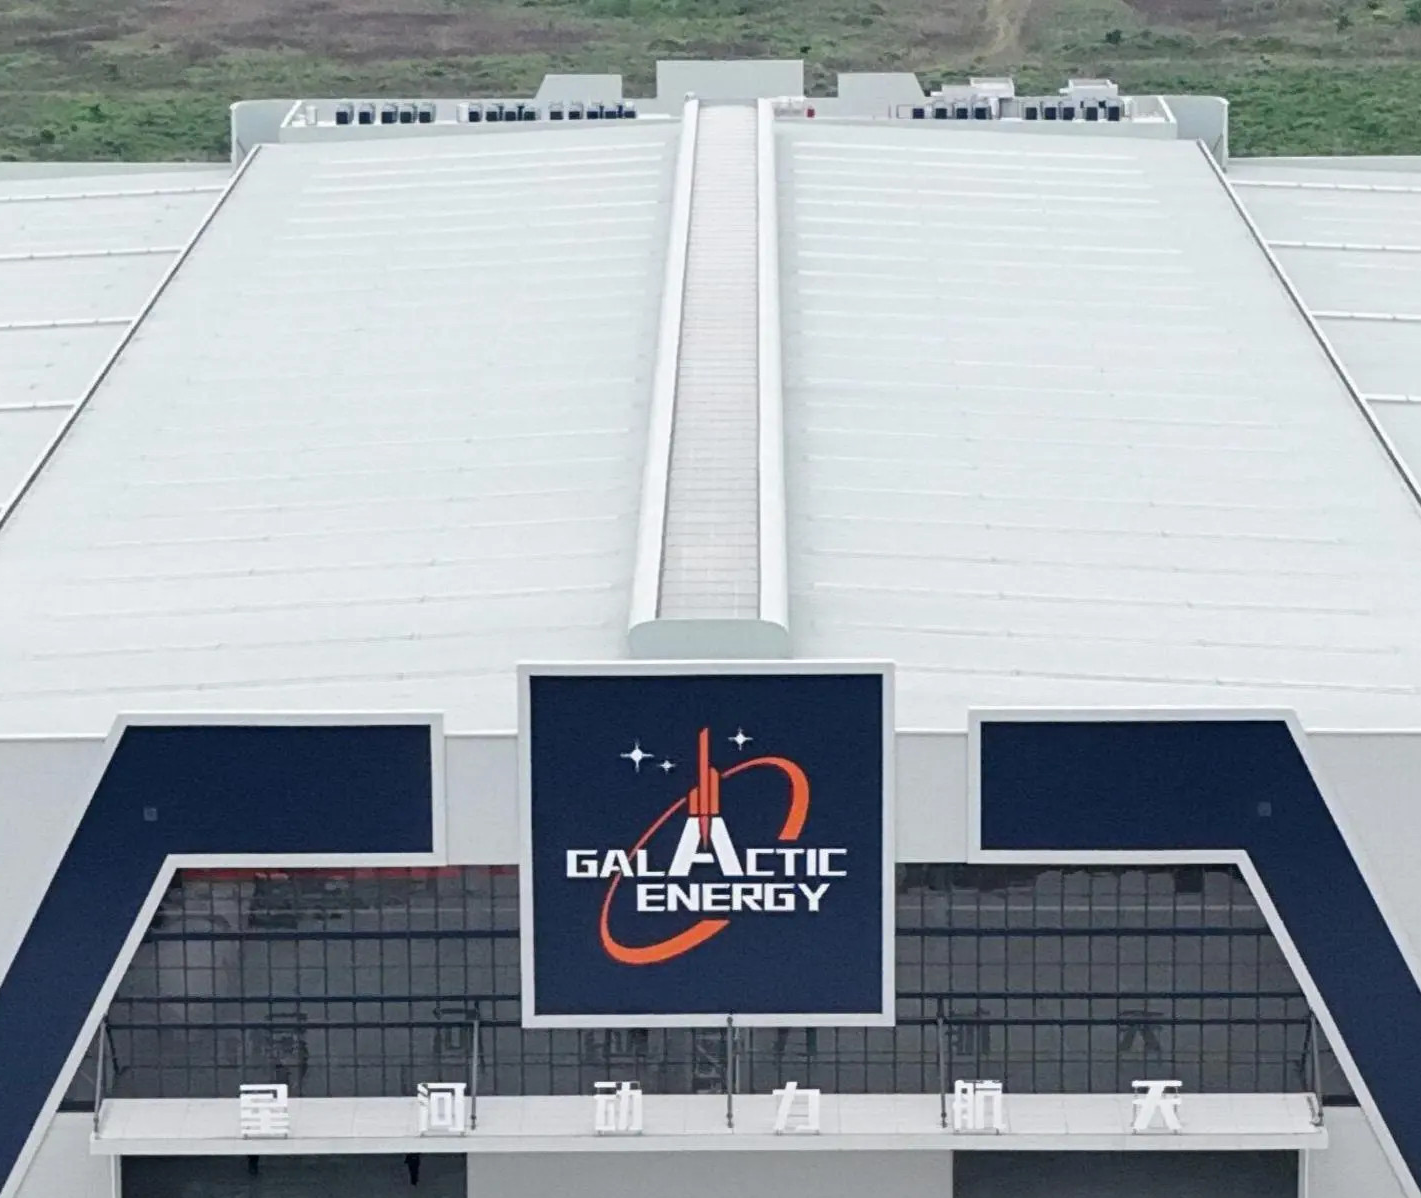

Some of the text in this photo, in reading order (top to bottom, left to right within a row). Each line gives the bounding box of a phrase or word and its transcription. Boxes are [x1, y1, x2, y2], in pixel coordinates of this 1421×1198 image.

[566, 816, 847, 878] GALACTIC
[636, 883, 831, 911] ENERGY
[239, 1079, 1183, 1135] 星河动力航天
